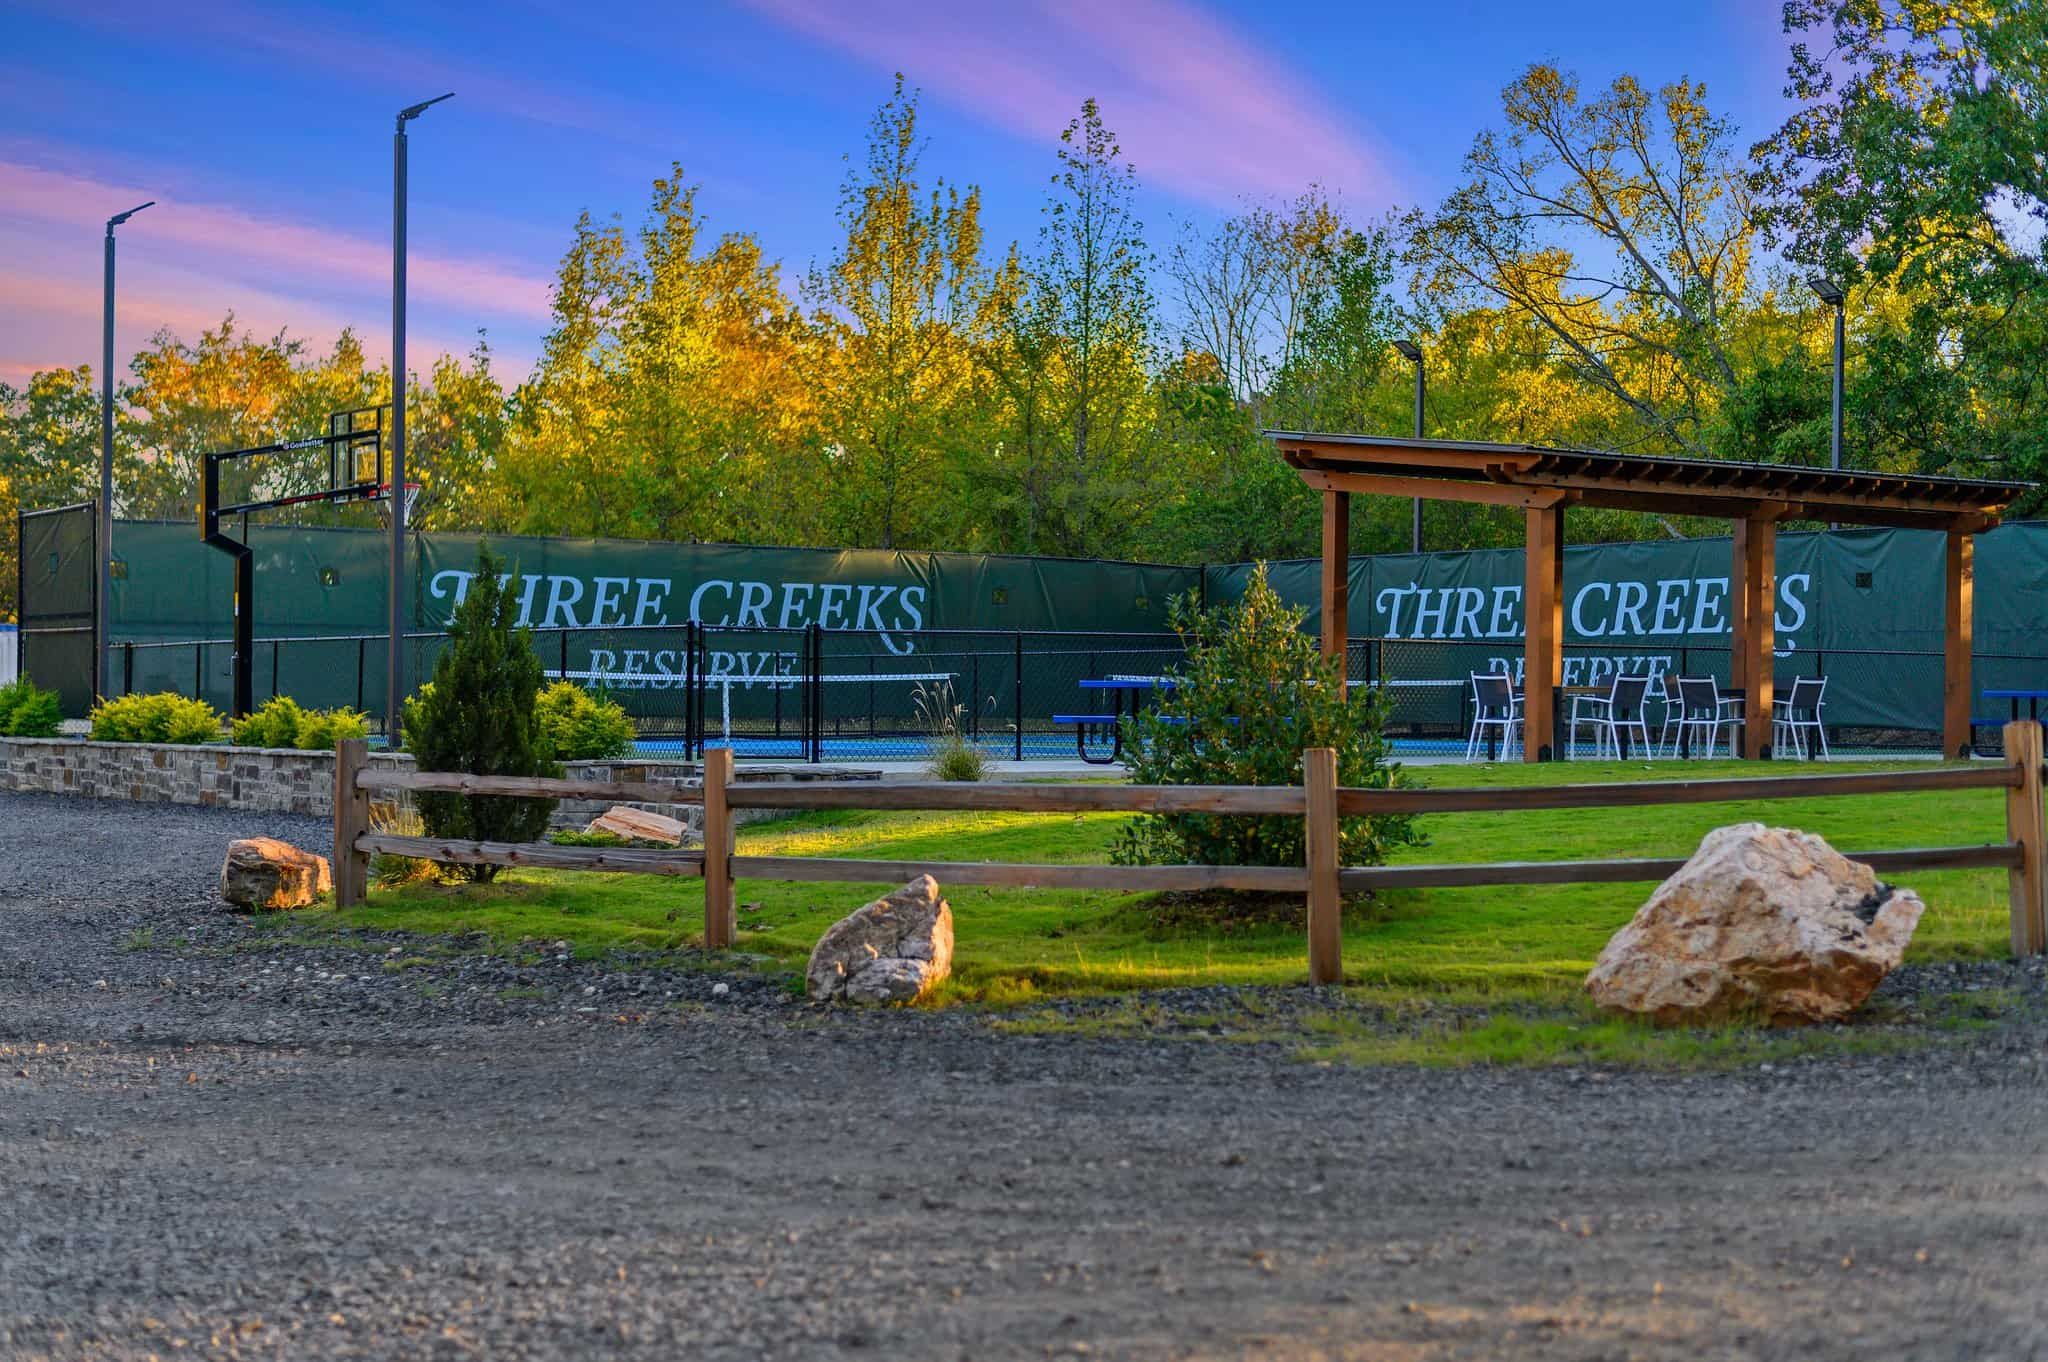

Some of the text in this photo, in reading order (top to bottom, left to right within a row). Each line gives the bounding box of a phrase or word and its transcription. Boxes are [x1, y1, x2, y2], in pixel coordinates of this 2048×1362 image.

[430, 569, 926, 656] THREE CREEKS
[1376, 573, 1810, 658] THRE CREES
